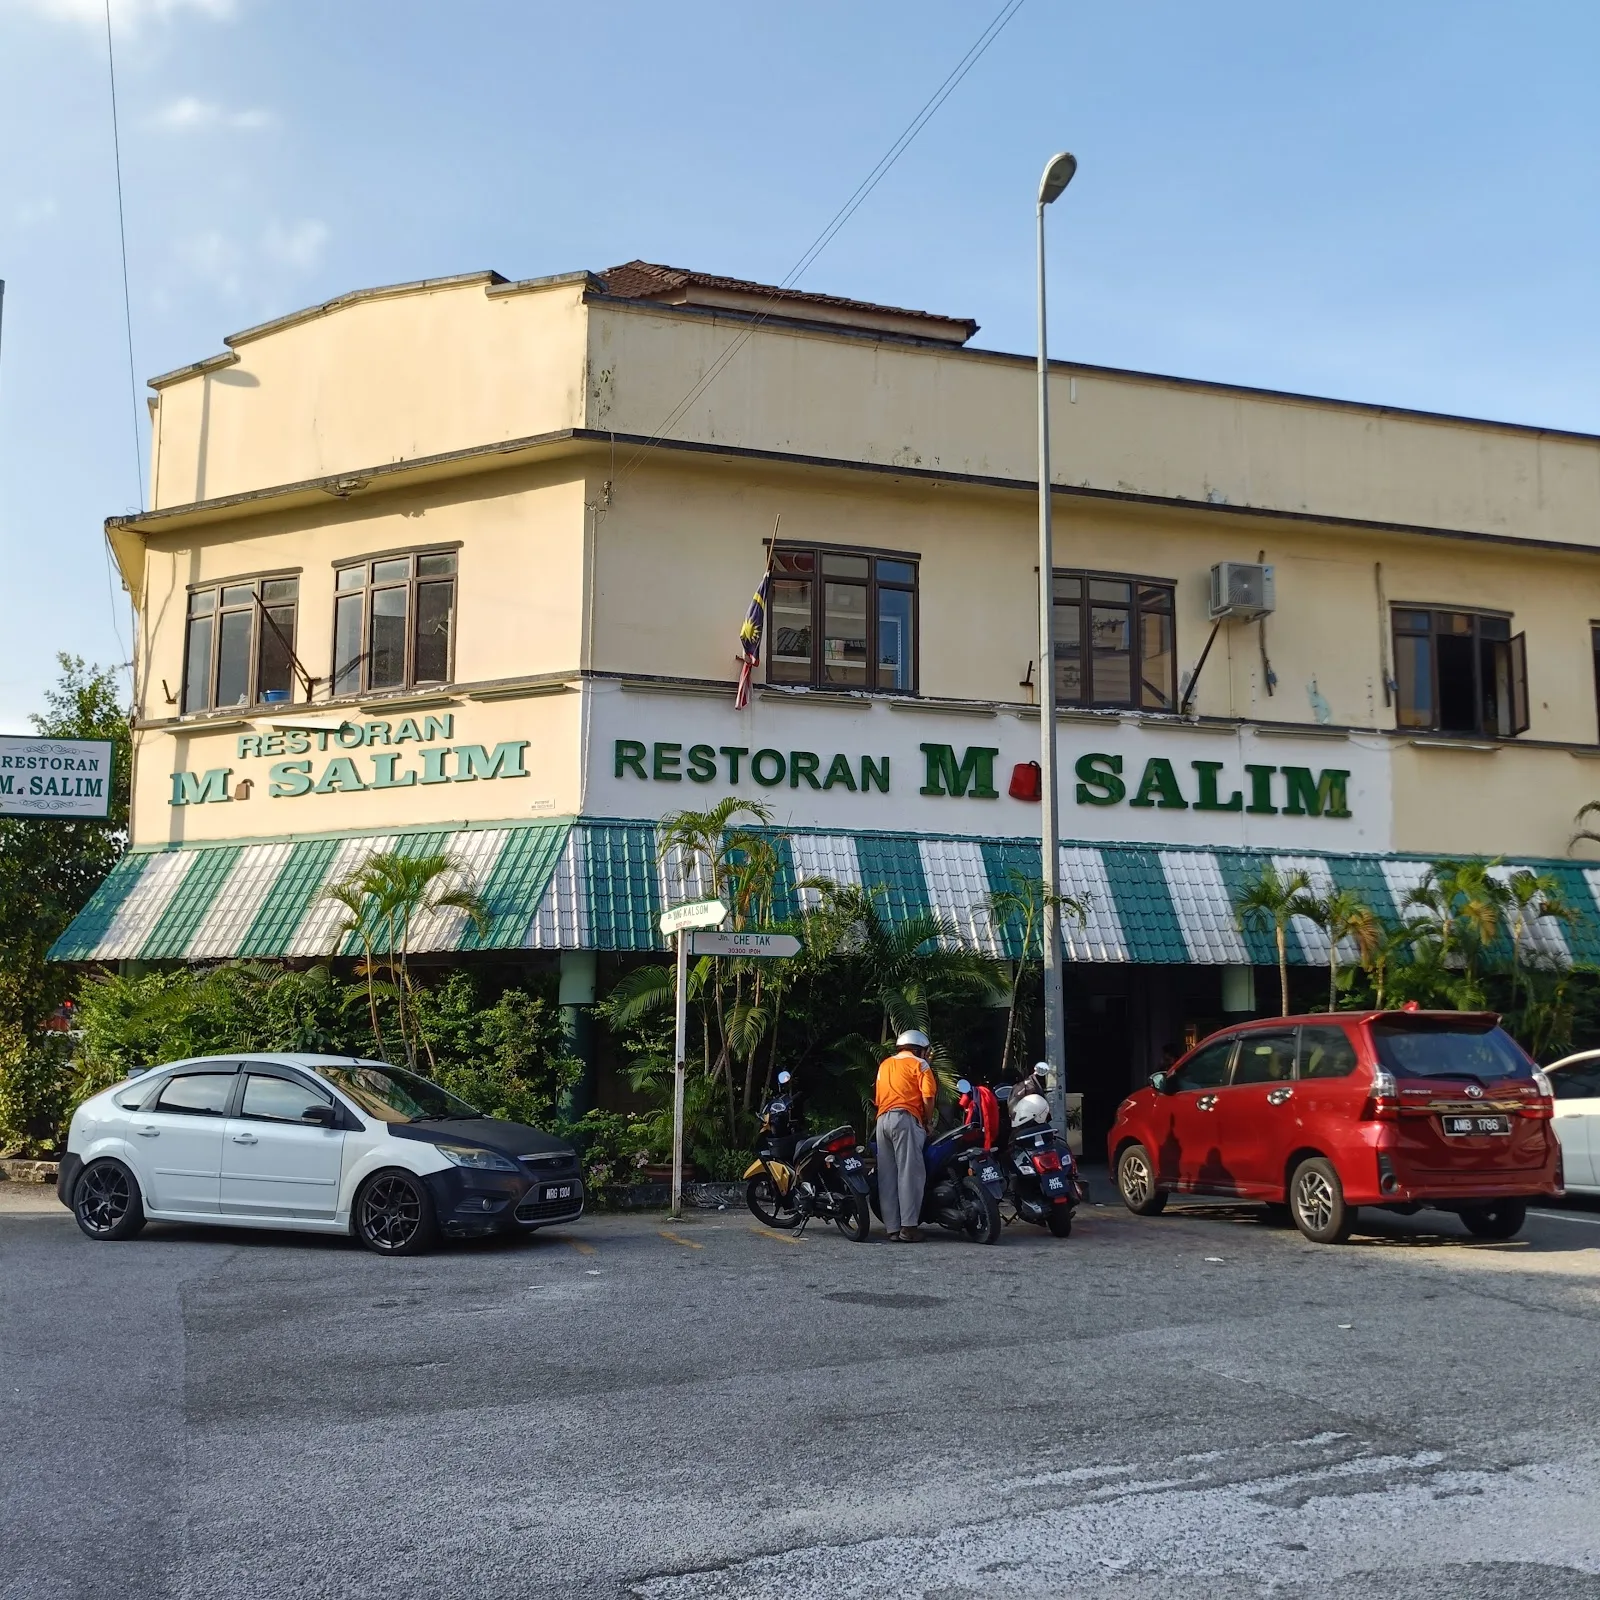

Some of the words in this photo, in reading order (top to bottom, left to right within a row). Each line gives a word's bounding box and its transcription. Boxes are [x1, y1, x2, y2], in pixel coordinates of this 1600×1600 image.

[237, 713, 455, 760] RESTORAN
[1, 755, 100, 772] RESTORAN
[268, 740, 531, 799] SALIM
[29, 775, 104, 798] SALIM
[614, 739, 890, 793] RESTORAN
[1074, 752, 1353, 818] SALIM
[683, 904, 709, 918] KALSOM
[718, 934, 730, 942] Jln.
[733, 935, 750, 946] CHE
[755, 935, 771, 946] TAK
[727, 947, 746, 955] 30300
[1453, 1119, 1472, 1131] AMB
